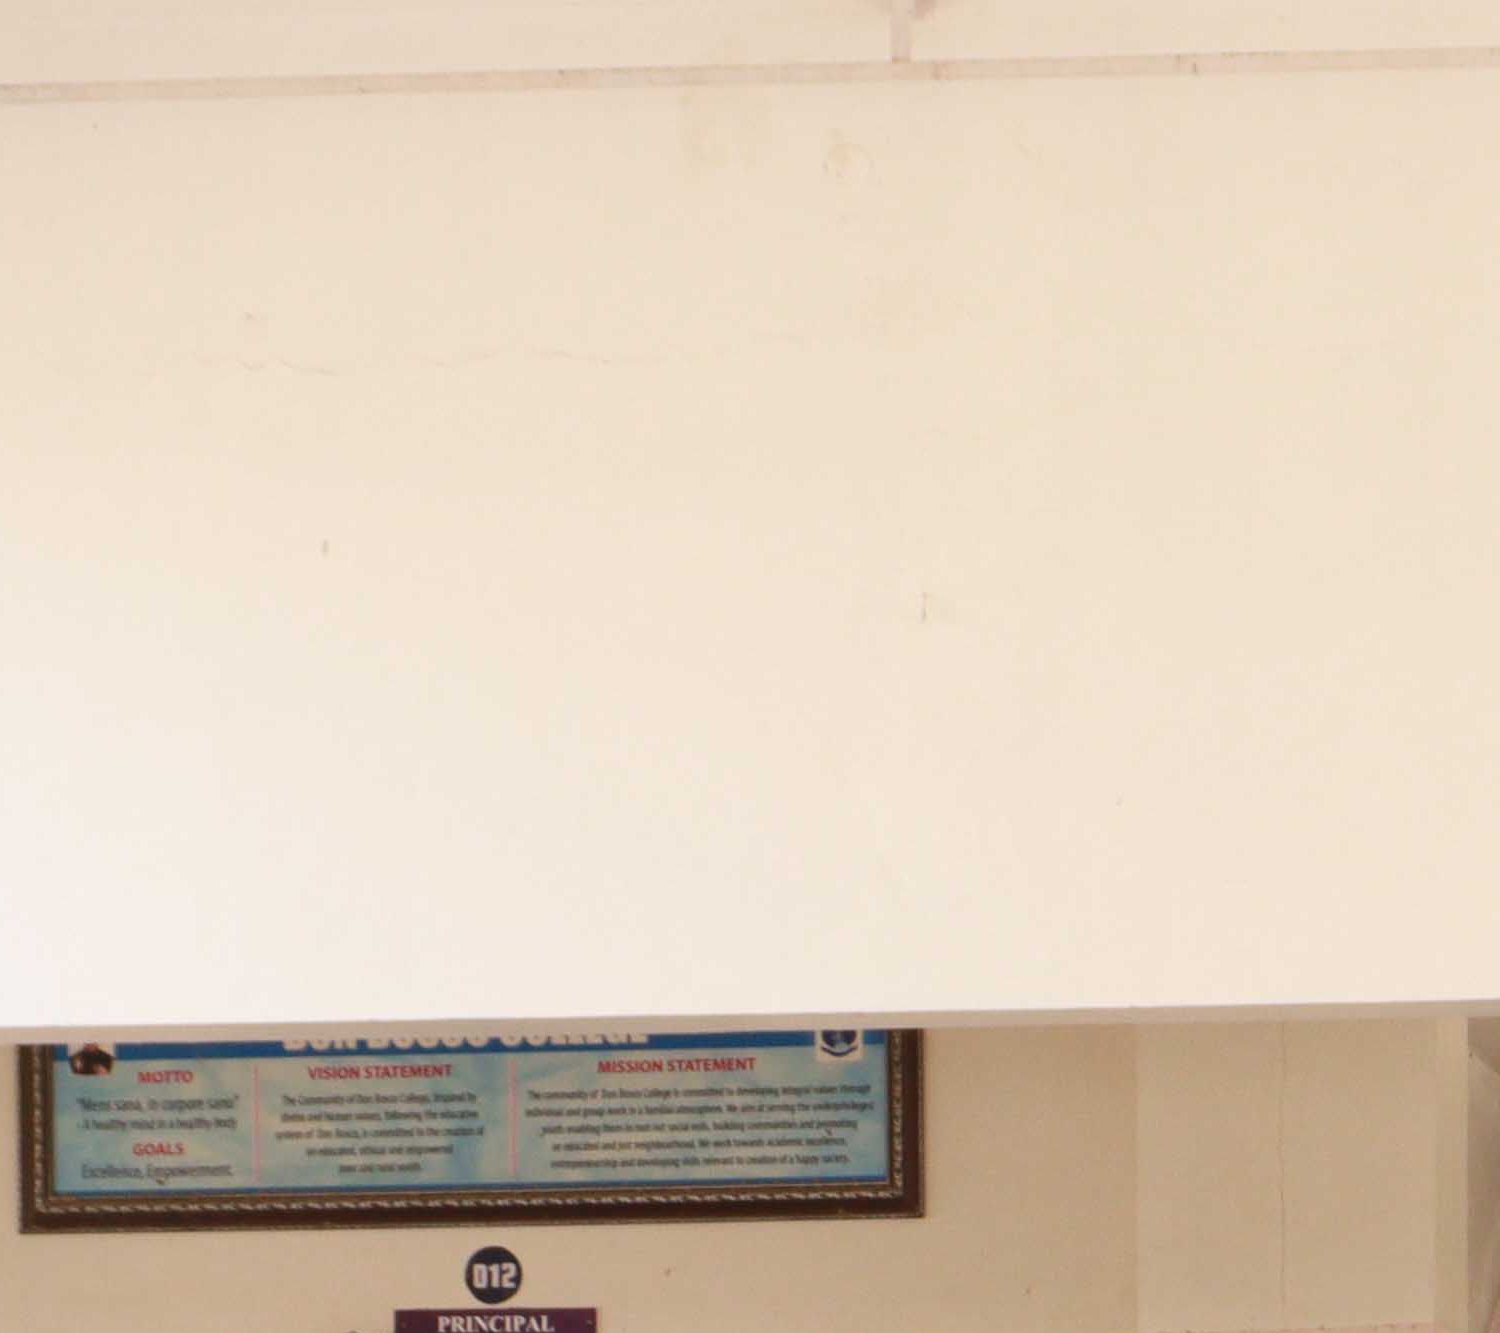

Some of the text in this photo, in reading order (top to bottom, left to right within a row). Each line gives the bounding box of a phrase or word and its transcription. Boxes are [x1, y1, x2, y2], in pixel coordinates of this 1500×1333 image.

[308, 1063, 453, 1080] VISION STATEMENT
[598, 1057, 756, 1073] MISSION STATEMENT
[137, 1070, 193, 1084] MOTTO
[132, 1142, 184, 1156] GOALS
[472, 1263, 517, 1288] 012
[438, 1315, 555, 1333] PRINCIPAL
